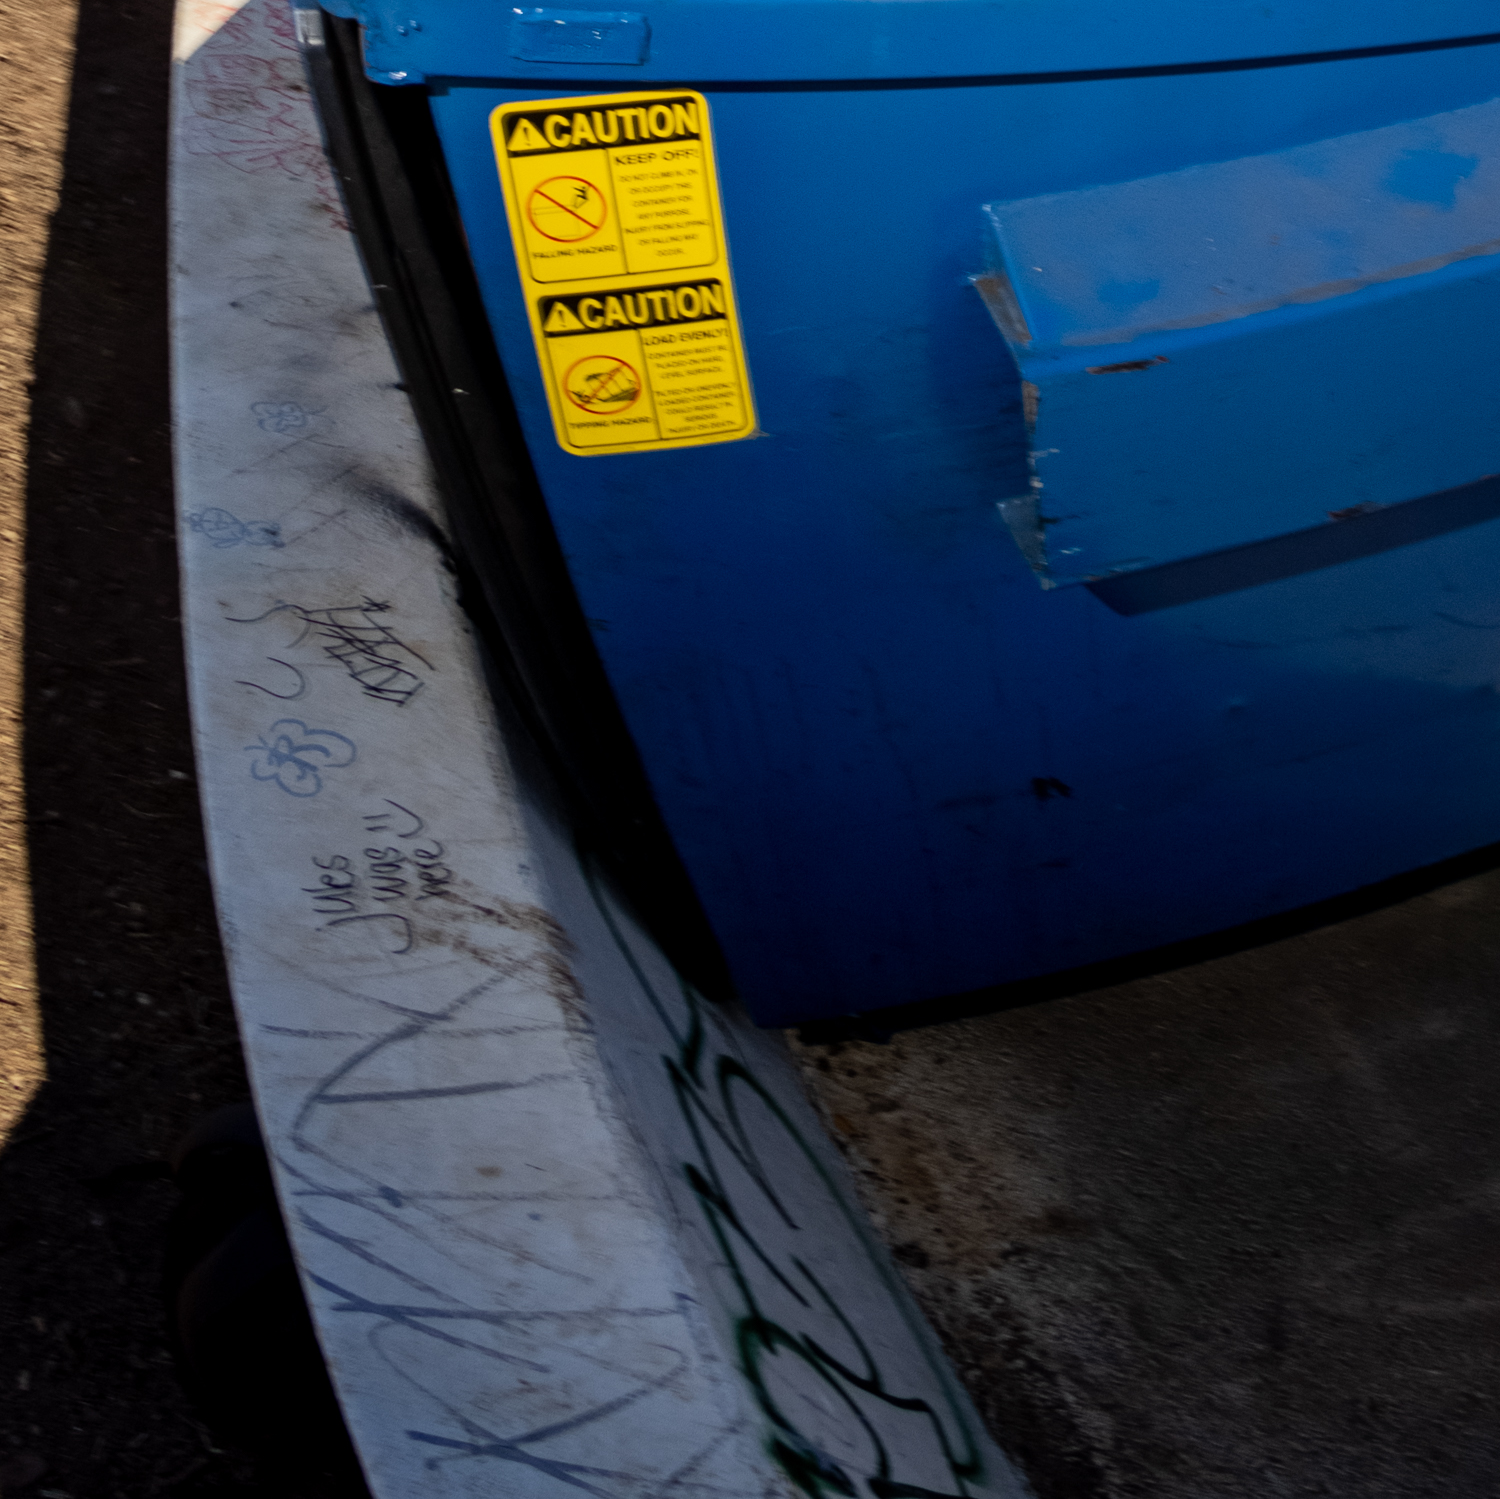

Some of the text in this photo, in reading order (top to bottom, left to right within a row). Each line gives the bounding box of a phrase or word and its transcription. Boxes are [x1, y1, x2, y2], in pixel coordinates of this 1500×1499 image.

[544, 102, 700, 148] CAUTION
[614, 152, 657, 165] KEEP
[533, 244, 618, 259] FALLING HAZARD
[578, 283, 726, 329] CAUTION
[643, 333, 677, 346] LOAD
[568, 415, 652, 430] TIPPING HAZARD
[364, 846, 410, 903] was
